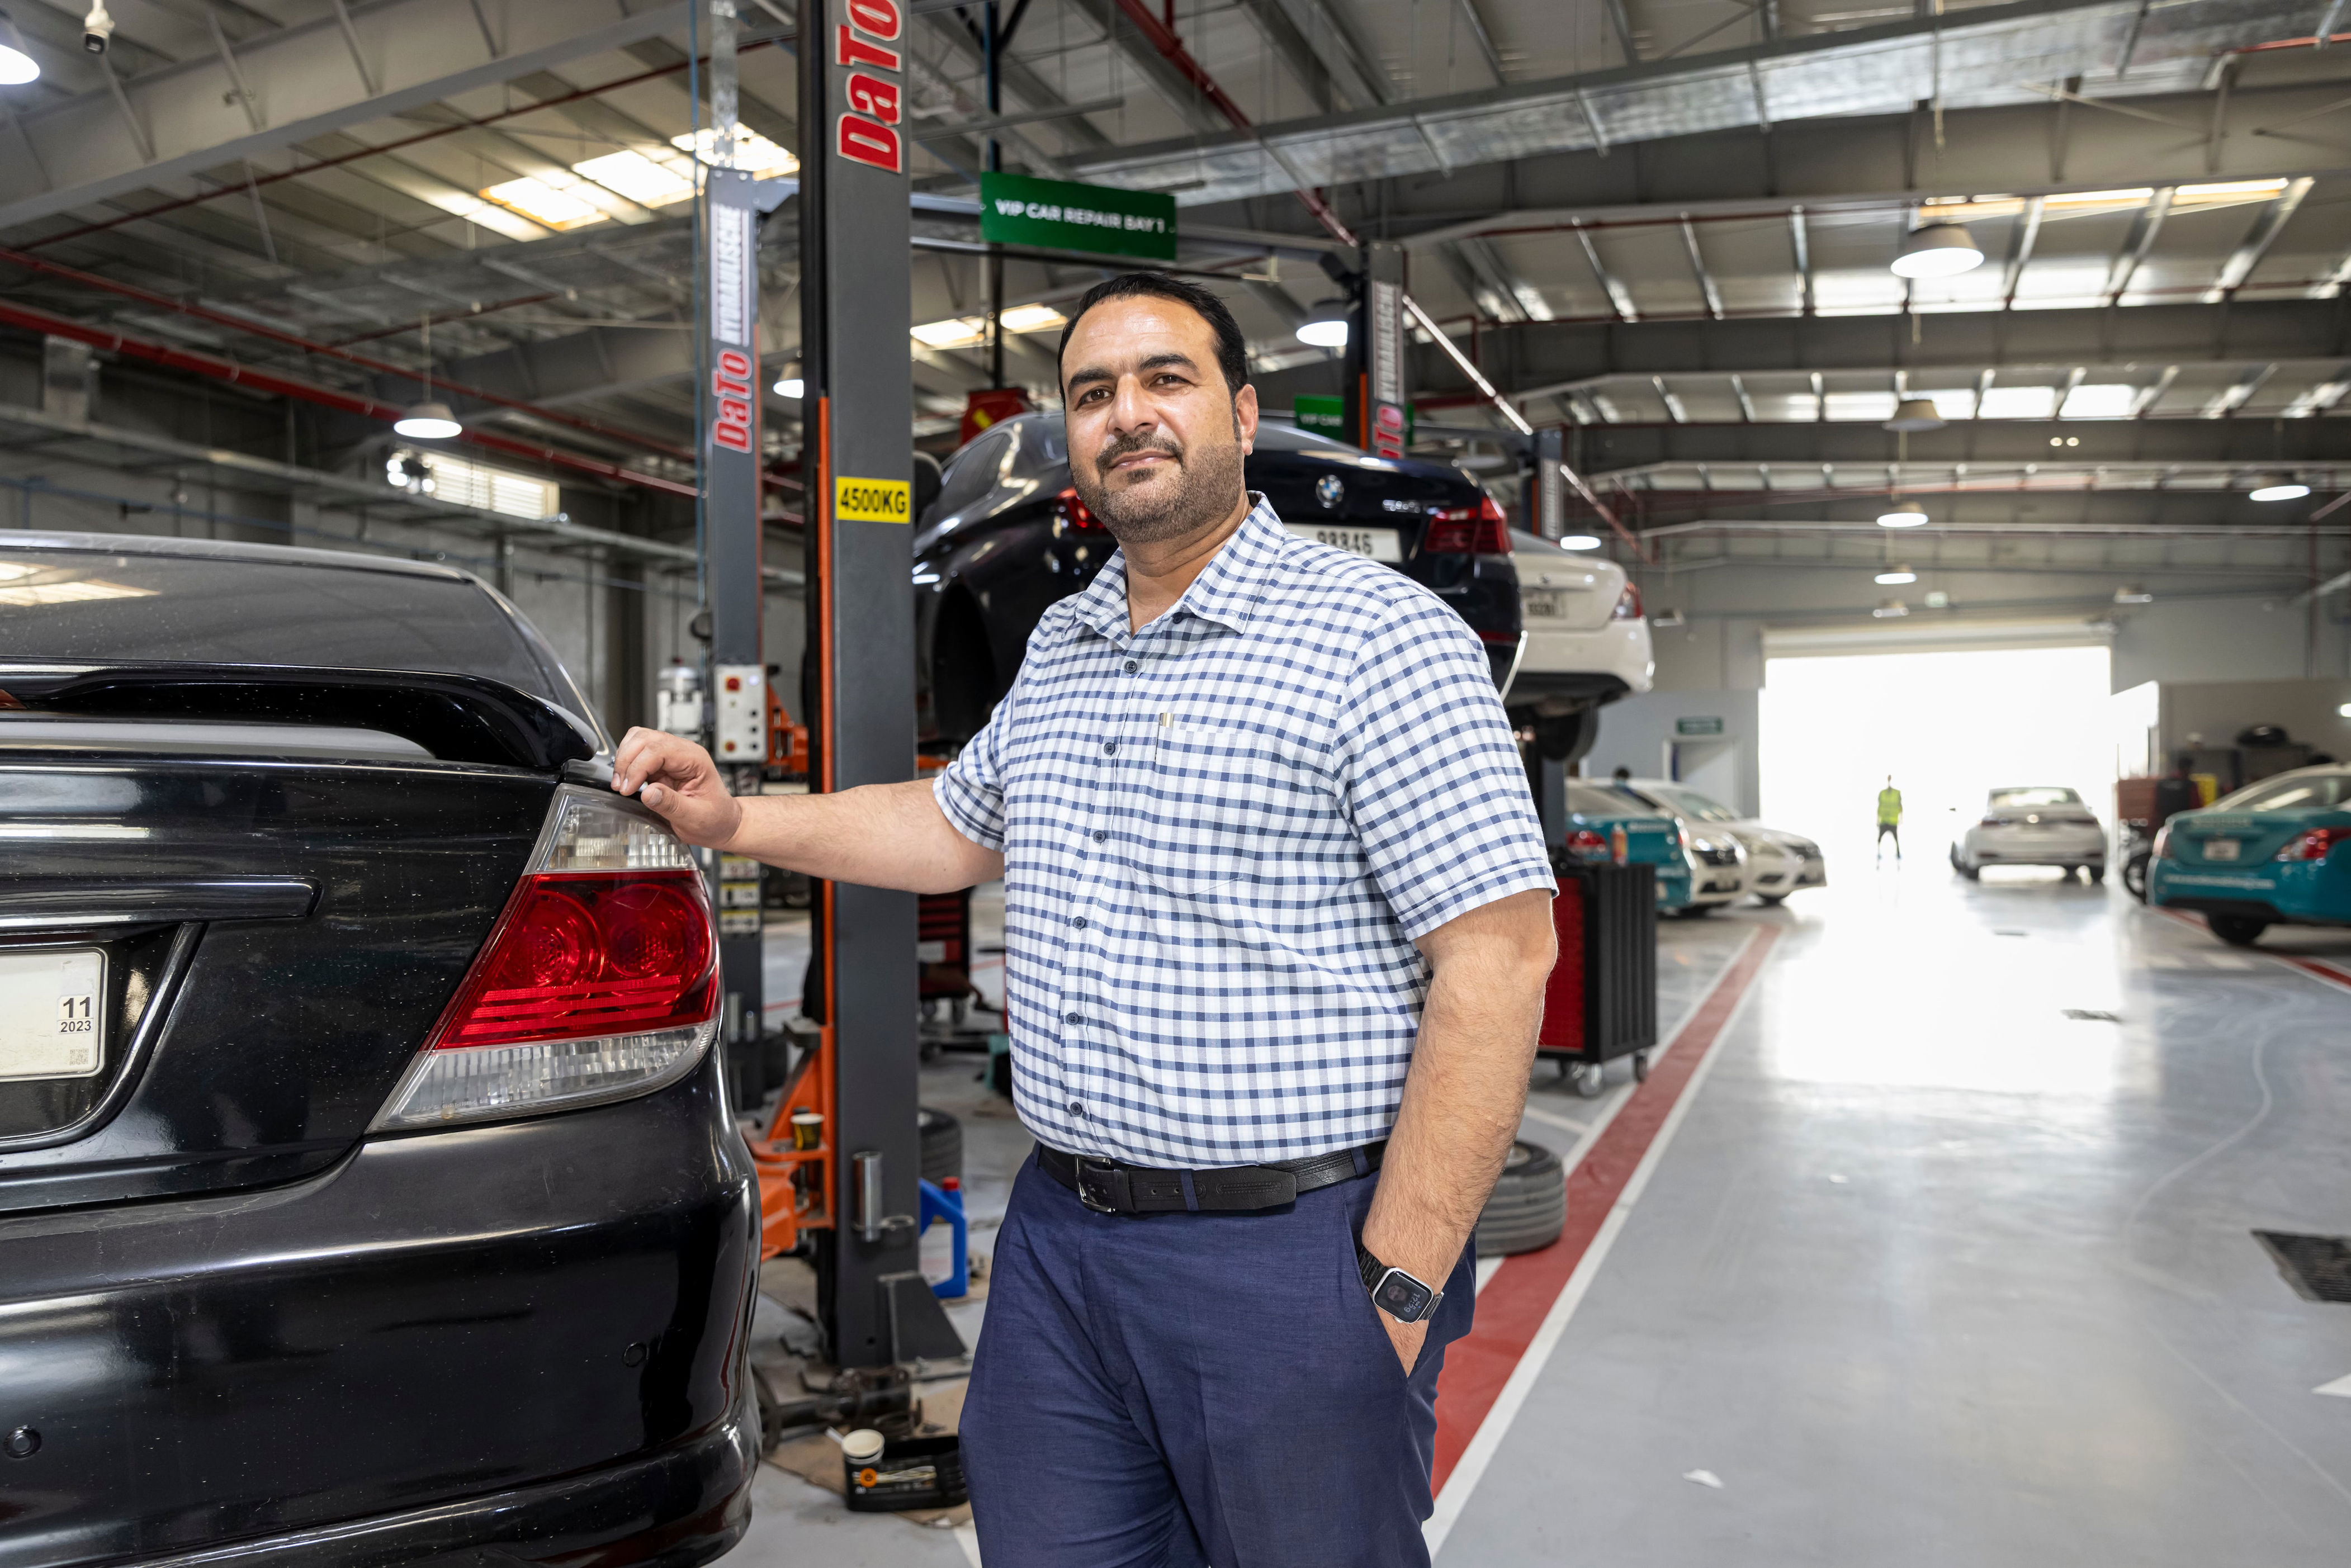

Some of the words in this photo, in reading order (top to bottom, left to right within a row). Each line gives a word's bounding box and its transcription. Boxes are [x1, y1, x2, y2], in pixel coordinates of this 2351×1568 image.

[836, 0, 902, 174] DaTo
[995, 198, 1025, 217] VIP
[1025, 202, 1062, 222] CAR
[1063, 207, 1122, 229] REPAIR
[1124, 214, 1156, 233] BAY
[711, 348, 753, 454] DaTo
[840, 487, 906, 514] 4500KG
[63, 996, 91, 1019] 11
[60, 1020, 92, 1033] 2023
